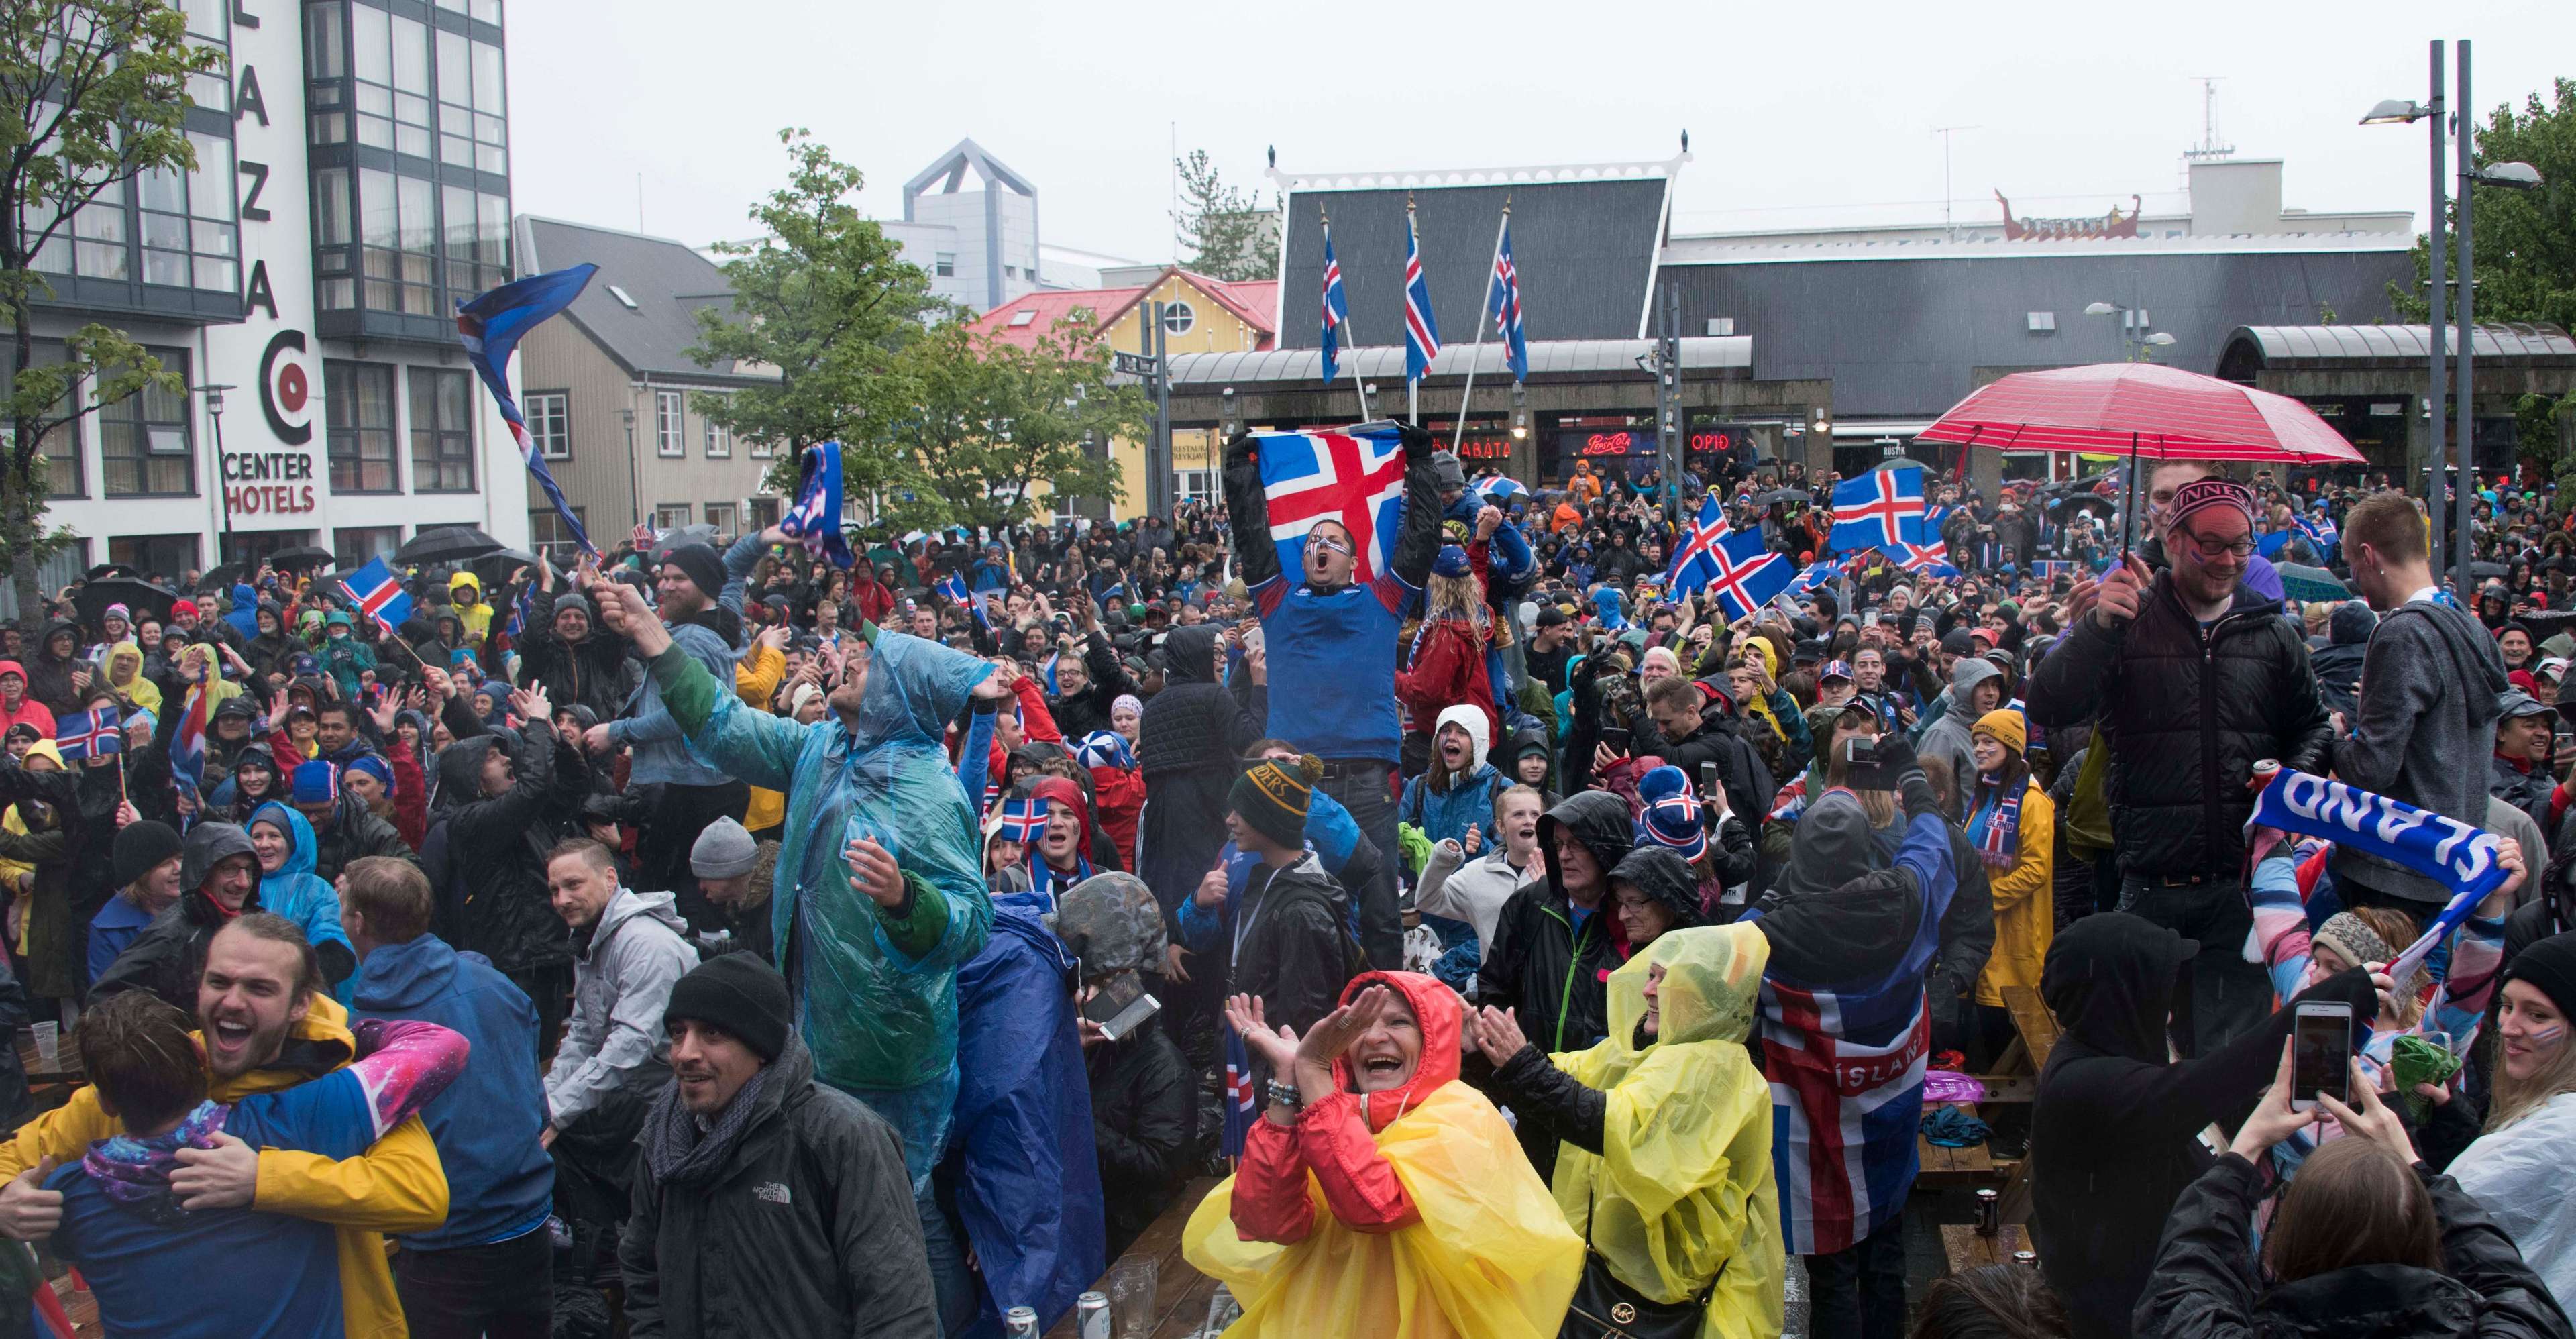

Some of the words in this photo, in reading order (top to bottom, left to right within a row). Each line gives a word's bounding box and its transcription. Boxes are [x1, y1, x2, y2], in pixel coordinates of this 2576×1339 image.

[224, 452, 313, 480] CENTER
[225, 485, 315, 514] HOTELS
[765, 1181, 779, 1190] THE
[752, 1186, 779, 1197] NORTH
[759, 1193, 777, 1201] FACE
